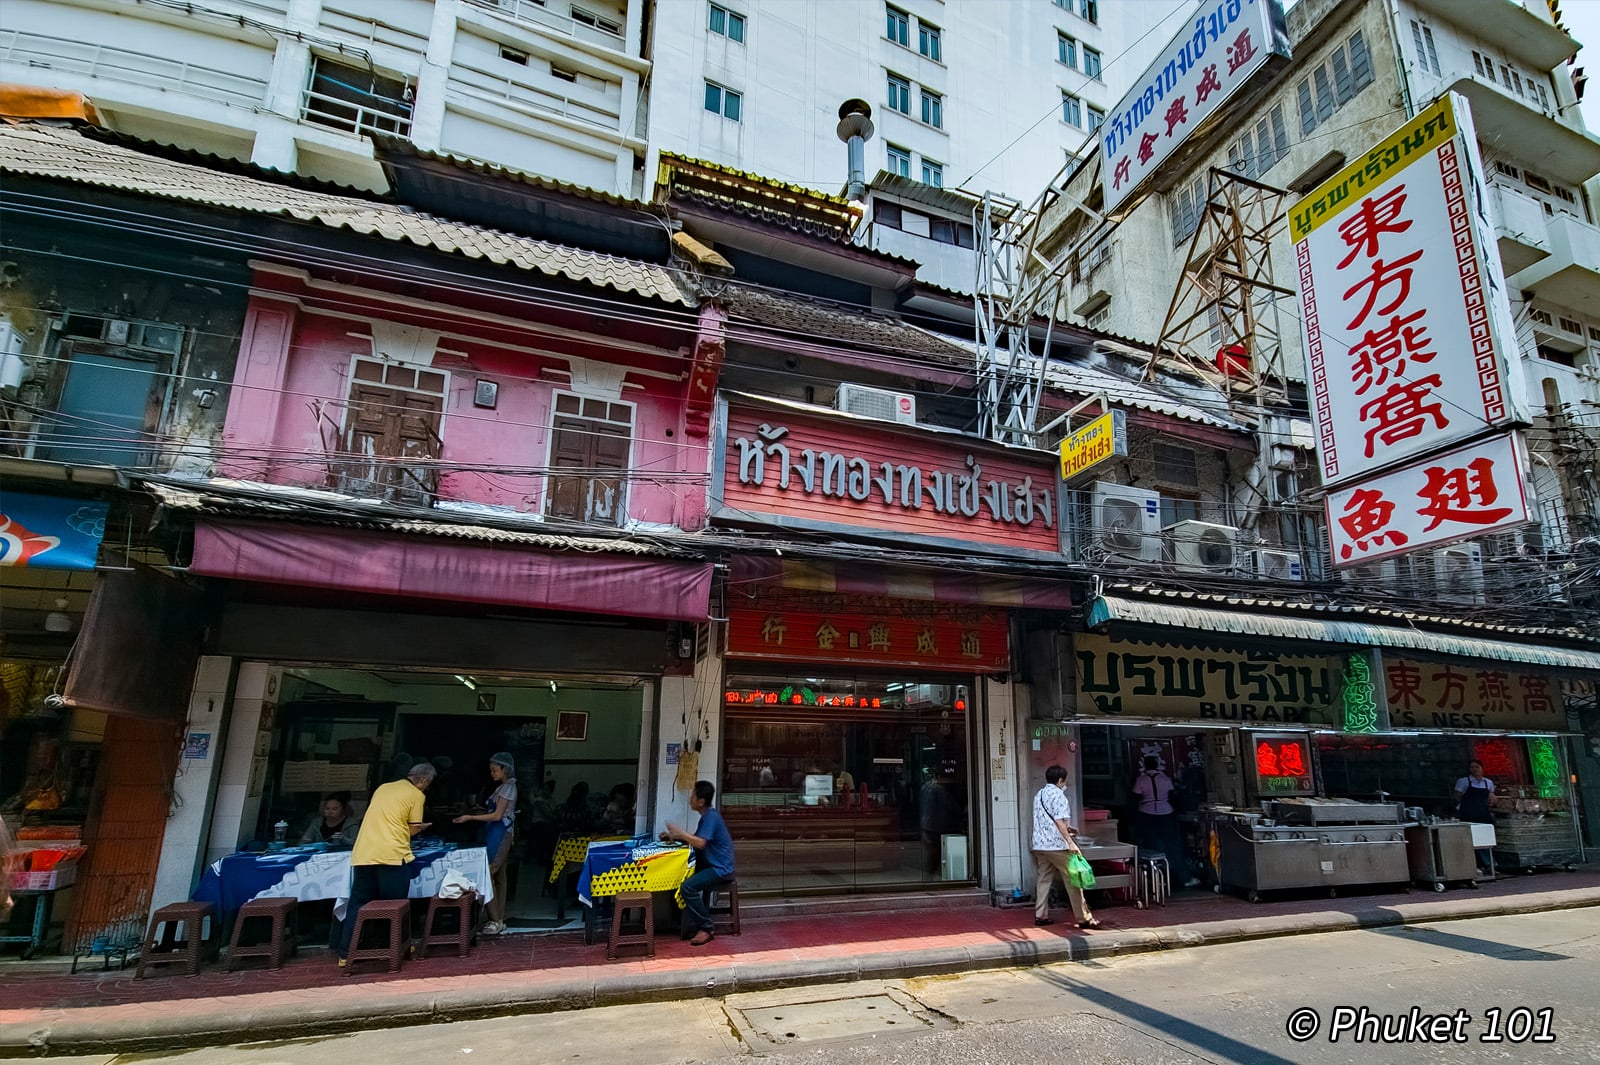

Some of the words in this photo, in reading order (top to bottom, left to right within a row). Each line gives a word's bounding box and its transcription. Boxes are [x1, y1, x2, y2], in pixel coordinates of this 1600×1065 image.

[1294, 111, 1449, 235] บูรพารังนก
[734, 422, 1053, 528] ห้างทองทงเซ่งเฮง
[1068, 424, 1103, 452] ห้างทอง
[1338, 457, 1513, 560] 魚翅
[1199, 701, 1309, 723] BURAP
[1432, 711, 1485, 728] NEST
